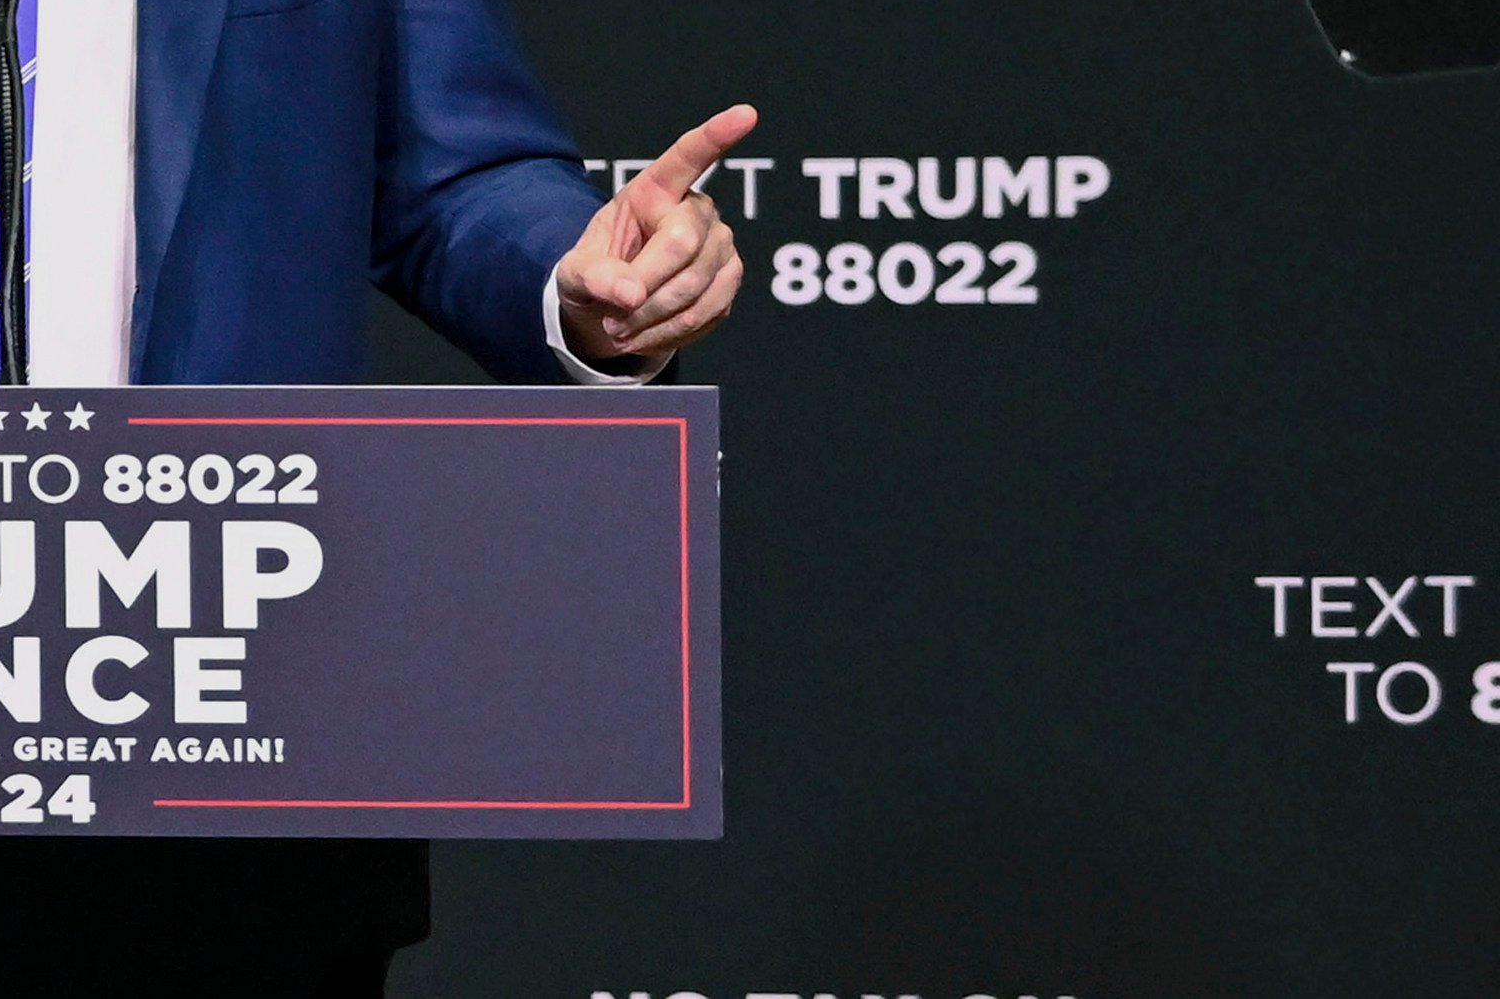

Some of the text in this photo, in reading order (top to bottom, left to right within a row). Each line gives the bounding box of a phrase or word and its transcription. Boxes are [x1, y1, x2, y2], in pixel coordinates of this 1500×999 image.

[801, 155, 1111, 220] TRUMP
[771, 241, 1039, 306] 88022
[102, 453, 319, 505] 88022
[1254, 575, 1475, 638] TEXT
[1325, 661, 1441, 725] TO
[12, 736, 138, 763] GREAT
[150, 737, 285, 764] AGAIN!
